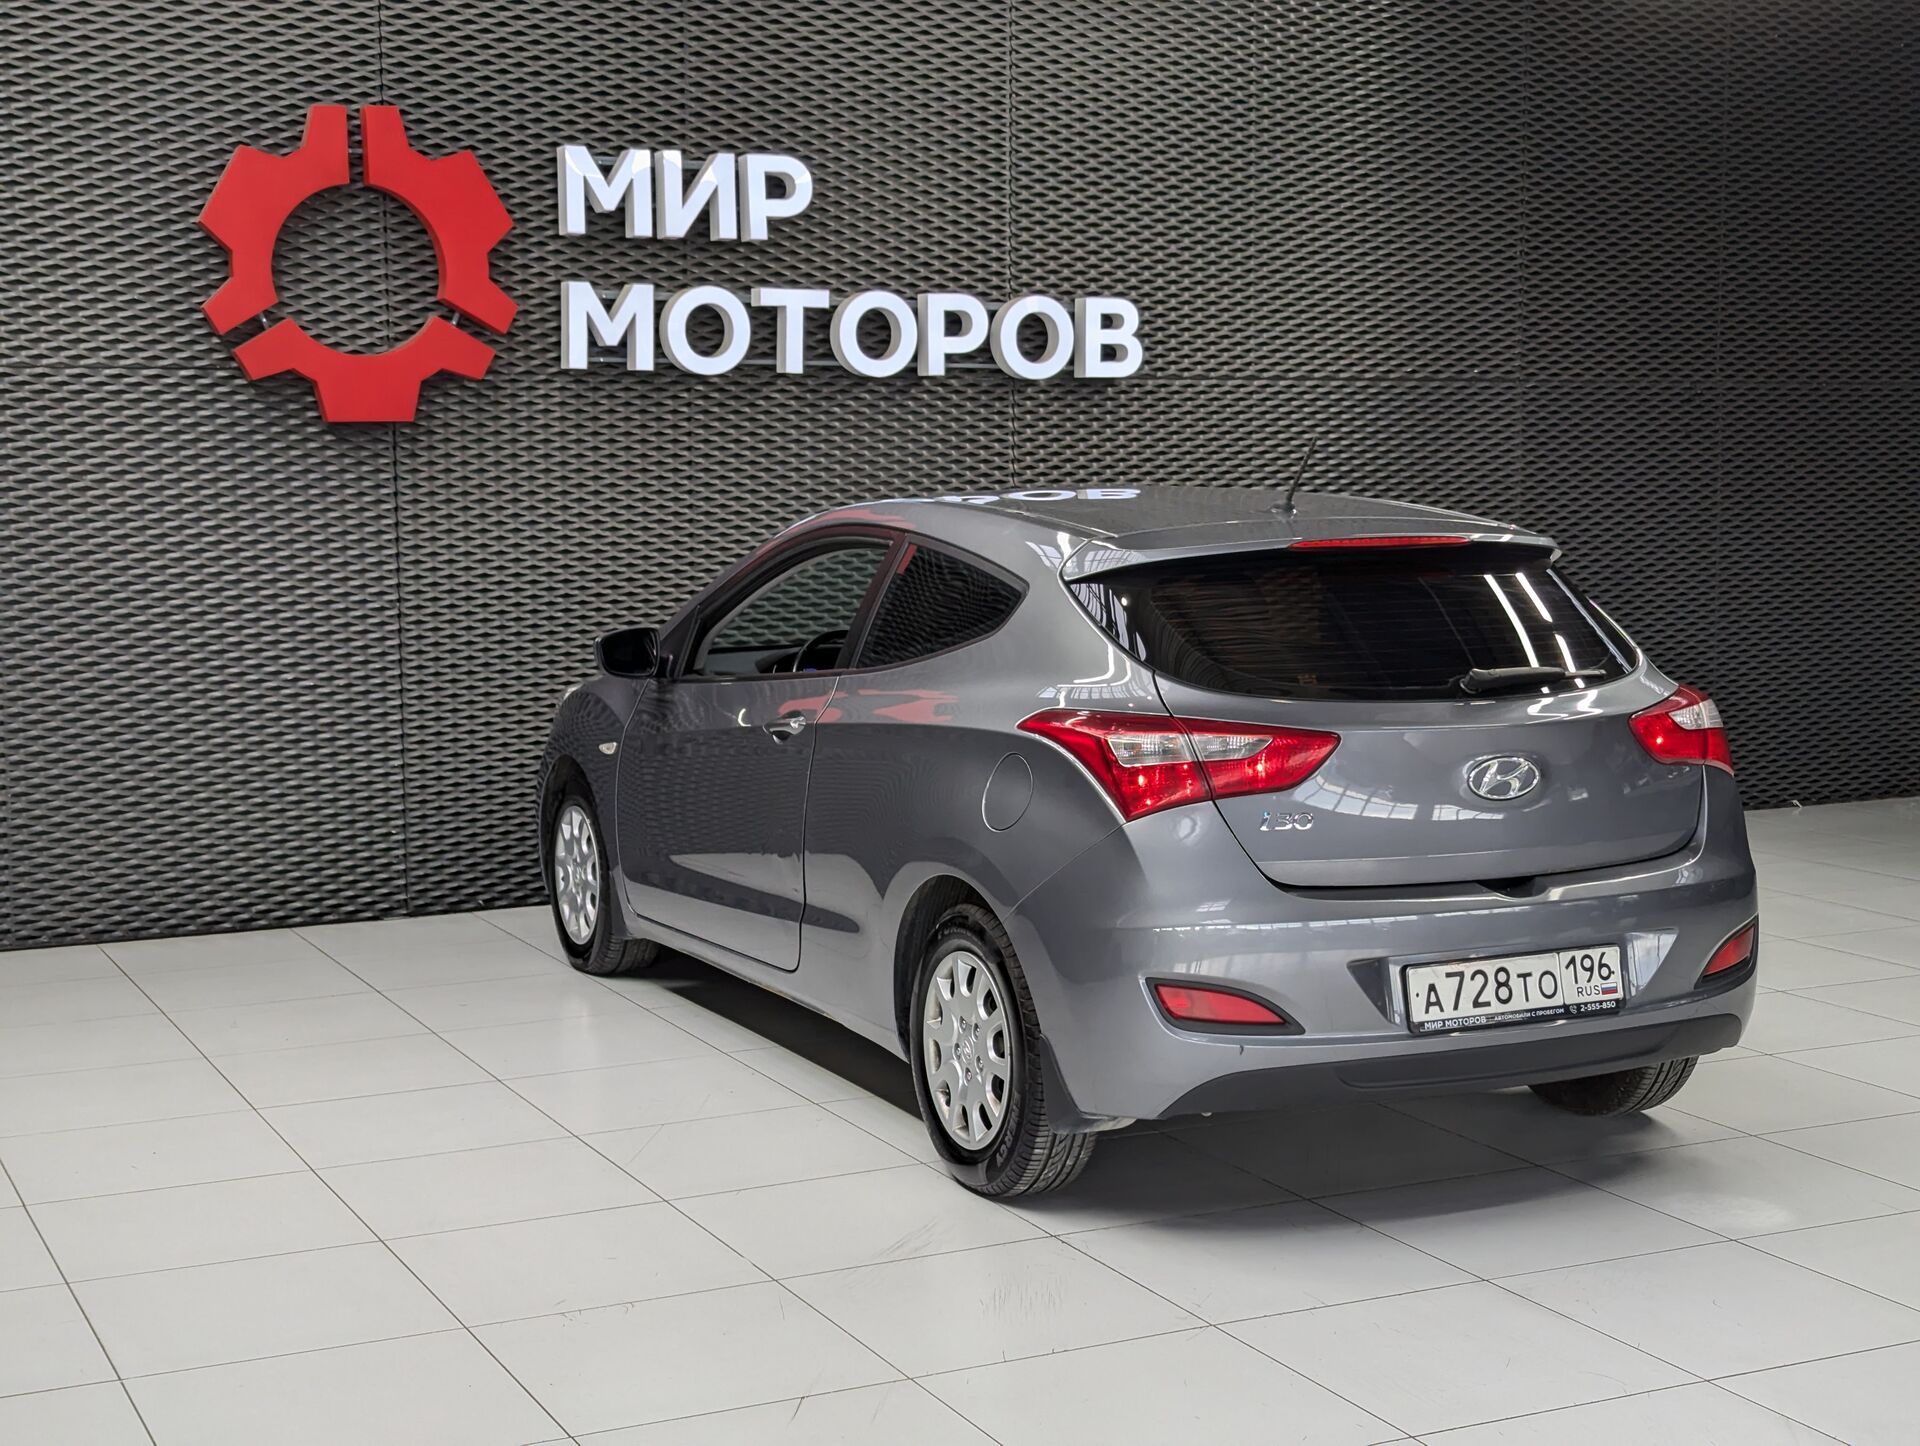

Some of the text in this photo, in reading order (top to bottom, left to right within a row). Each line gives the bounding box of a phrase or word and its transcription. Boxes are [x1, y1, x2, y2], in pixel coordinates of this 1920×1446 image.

[556, 145, 813, 242] МИР
[560, 281, 1144, 379] МОТОРОВ
[1565, 952, 1612, 985] 196
[1424, 966, 1558, 1014] А728ТО
[1577, 985, 1601, 997] RUS
[1580, 1001, 1616, 1012] 2-555-850
[1424, 1016, 1487, 1030] МИР МОТОРОВ
